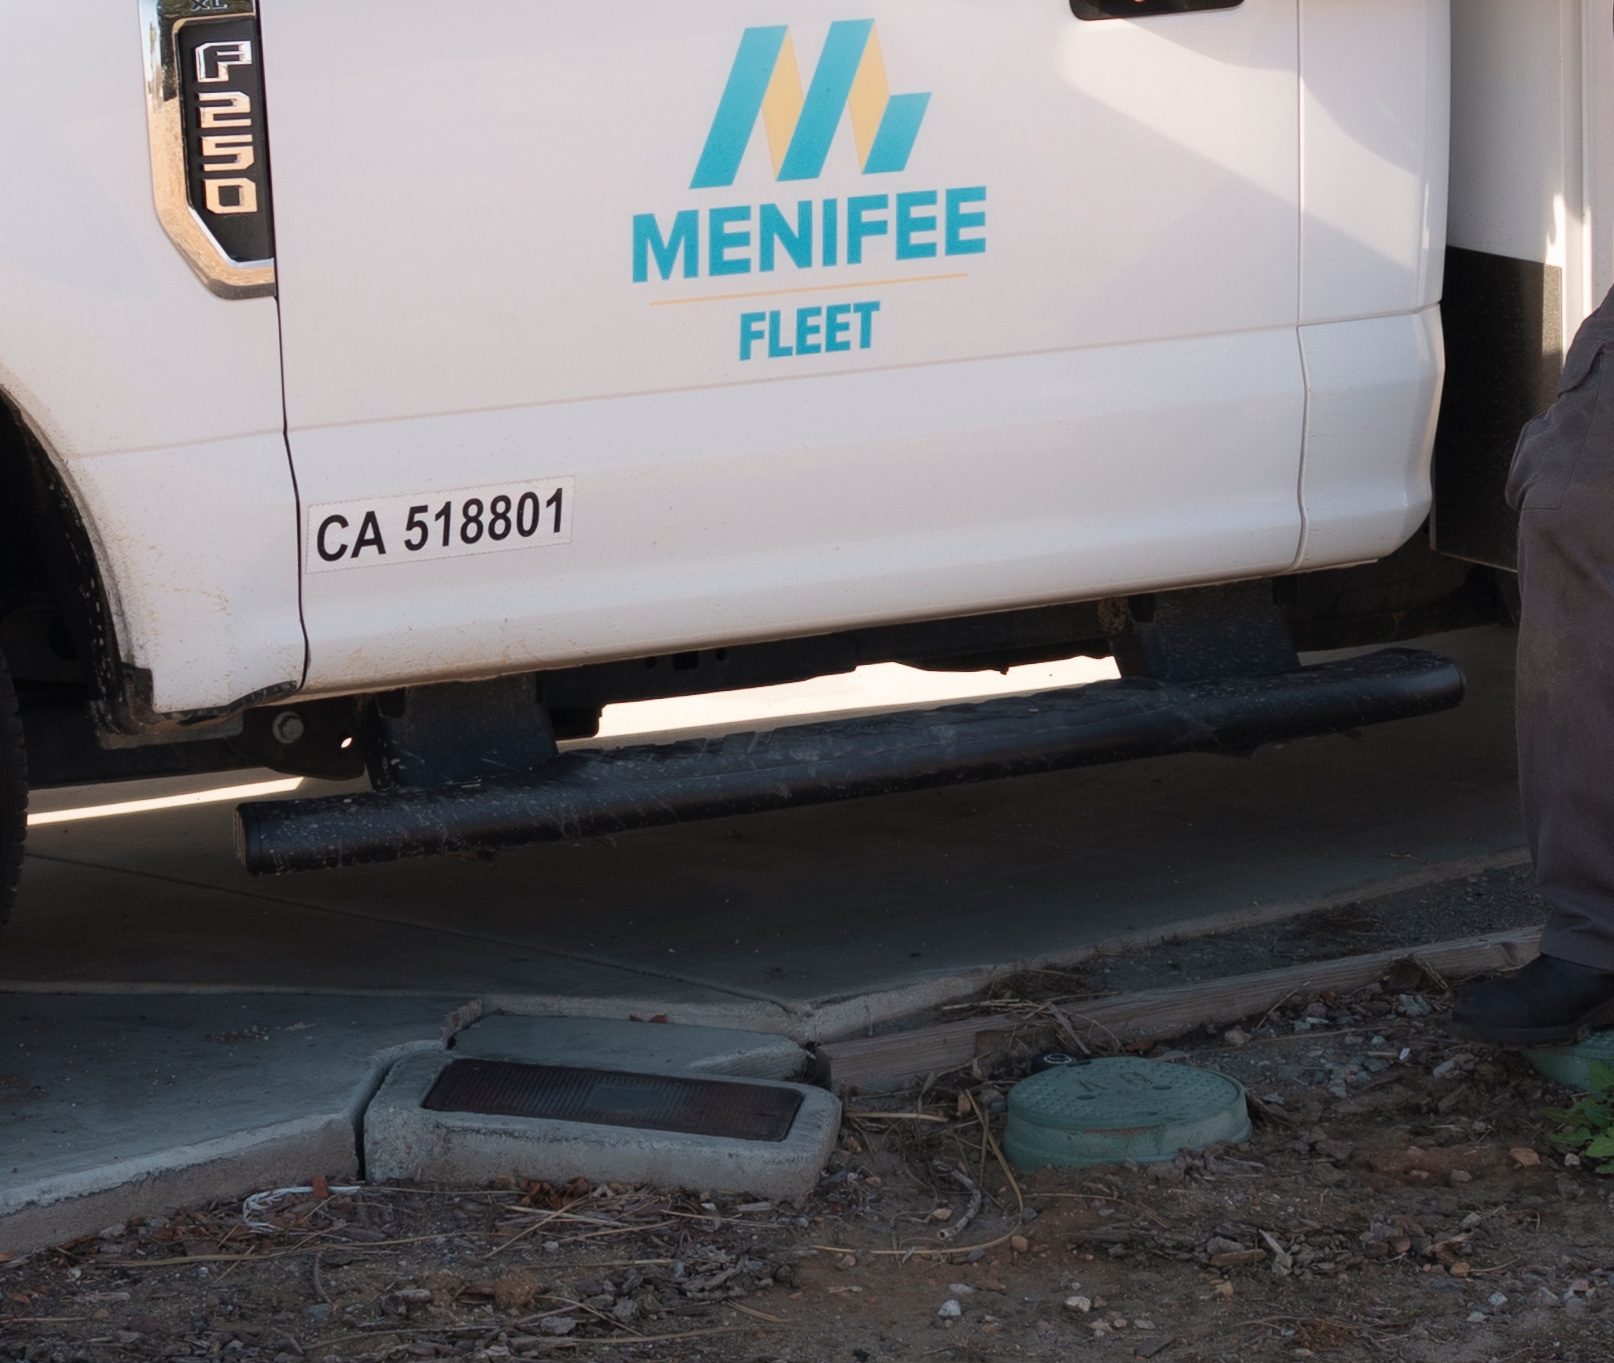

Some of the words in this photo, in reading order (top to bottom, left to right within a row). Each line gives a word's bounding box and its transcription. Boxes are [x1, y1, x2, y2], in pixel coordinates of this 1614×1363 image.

[193, 40, 259, 216] F250
[632, 185, 987, 284] MENIFEE
[739, 300, 881, 361] FLEET
[316, 510, 387, 562] CA
[403, 487, 564, 552] 518801
